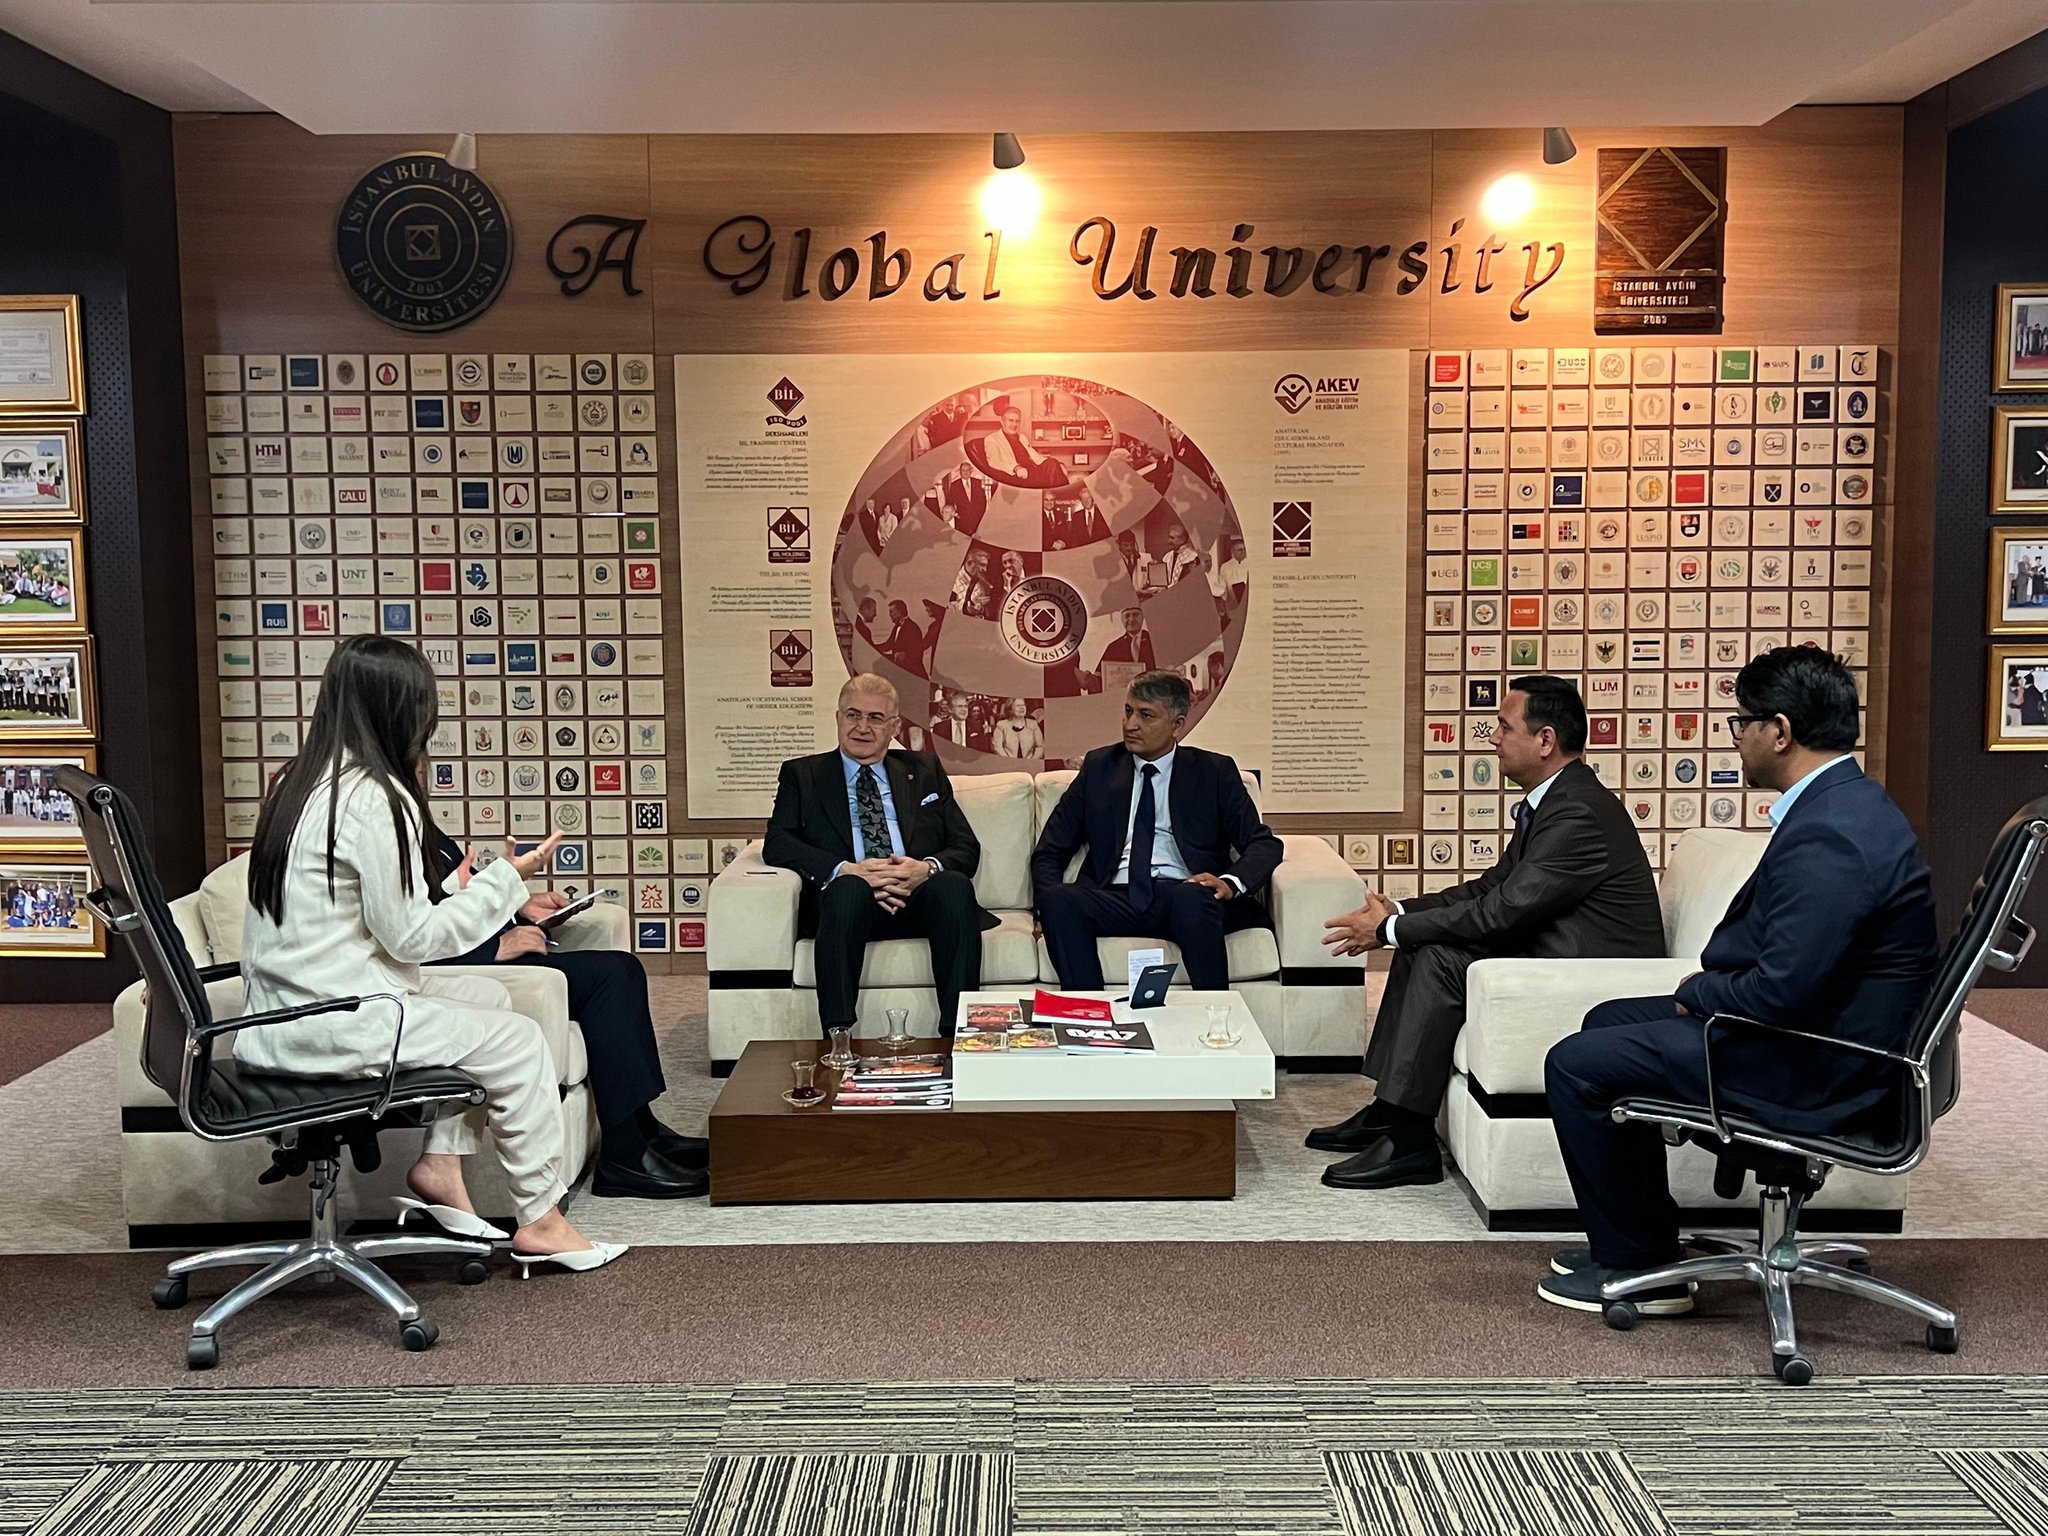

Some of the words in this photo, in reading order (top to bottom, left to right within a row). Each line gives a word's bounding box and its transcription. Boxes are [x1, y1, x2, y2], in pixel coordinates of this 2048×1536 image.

[342, 162, 439, 234] İSTANBUL
[443, 177, 498, 233] AYDIN
[546, 214, 647, 296] A
[703, 214, 1003, 302] Global
[1070, 215, 1566, 323] University
[1666, 281, 1696, 291] AYDIN
[1643, 314, 1668, 325] 2003
[1315, 378, 1360, 392] AKEV
[340, 491, 358, 502] CAL
[358, 491, 366, 501] U
[341, 569, 367, 579] UNT
[266, 618, 287, 627] RUB
[1592, 681, 1619, 692] LUM
[1474, 846, 1493, 854] EIA
